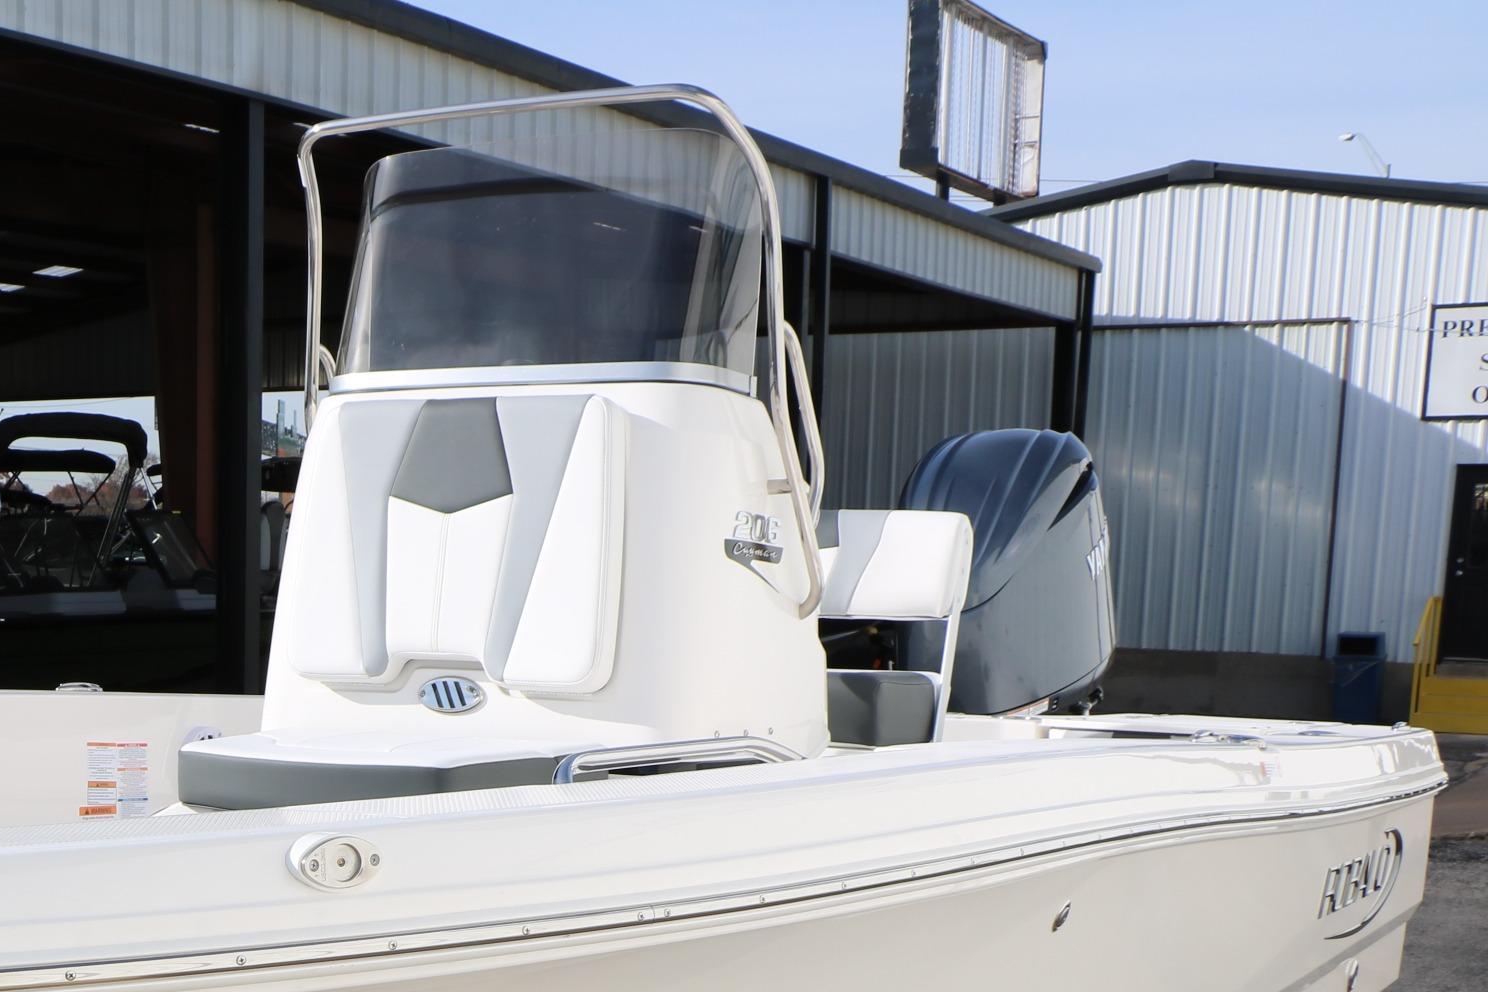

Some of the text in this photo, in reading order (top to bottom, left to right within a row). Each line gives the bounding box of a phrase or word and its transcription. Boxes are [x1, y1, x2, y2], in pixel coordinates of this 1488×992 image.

[733, 510, 779, 543] 206
[733, 542, 778, 558] Cayman
[1318, 842, 1391, 919] ROBALO
